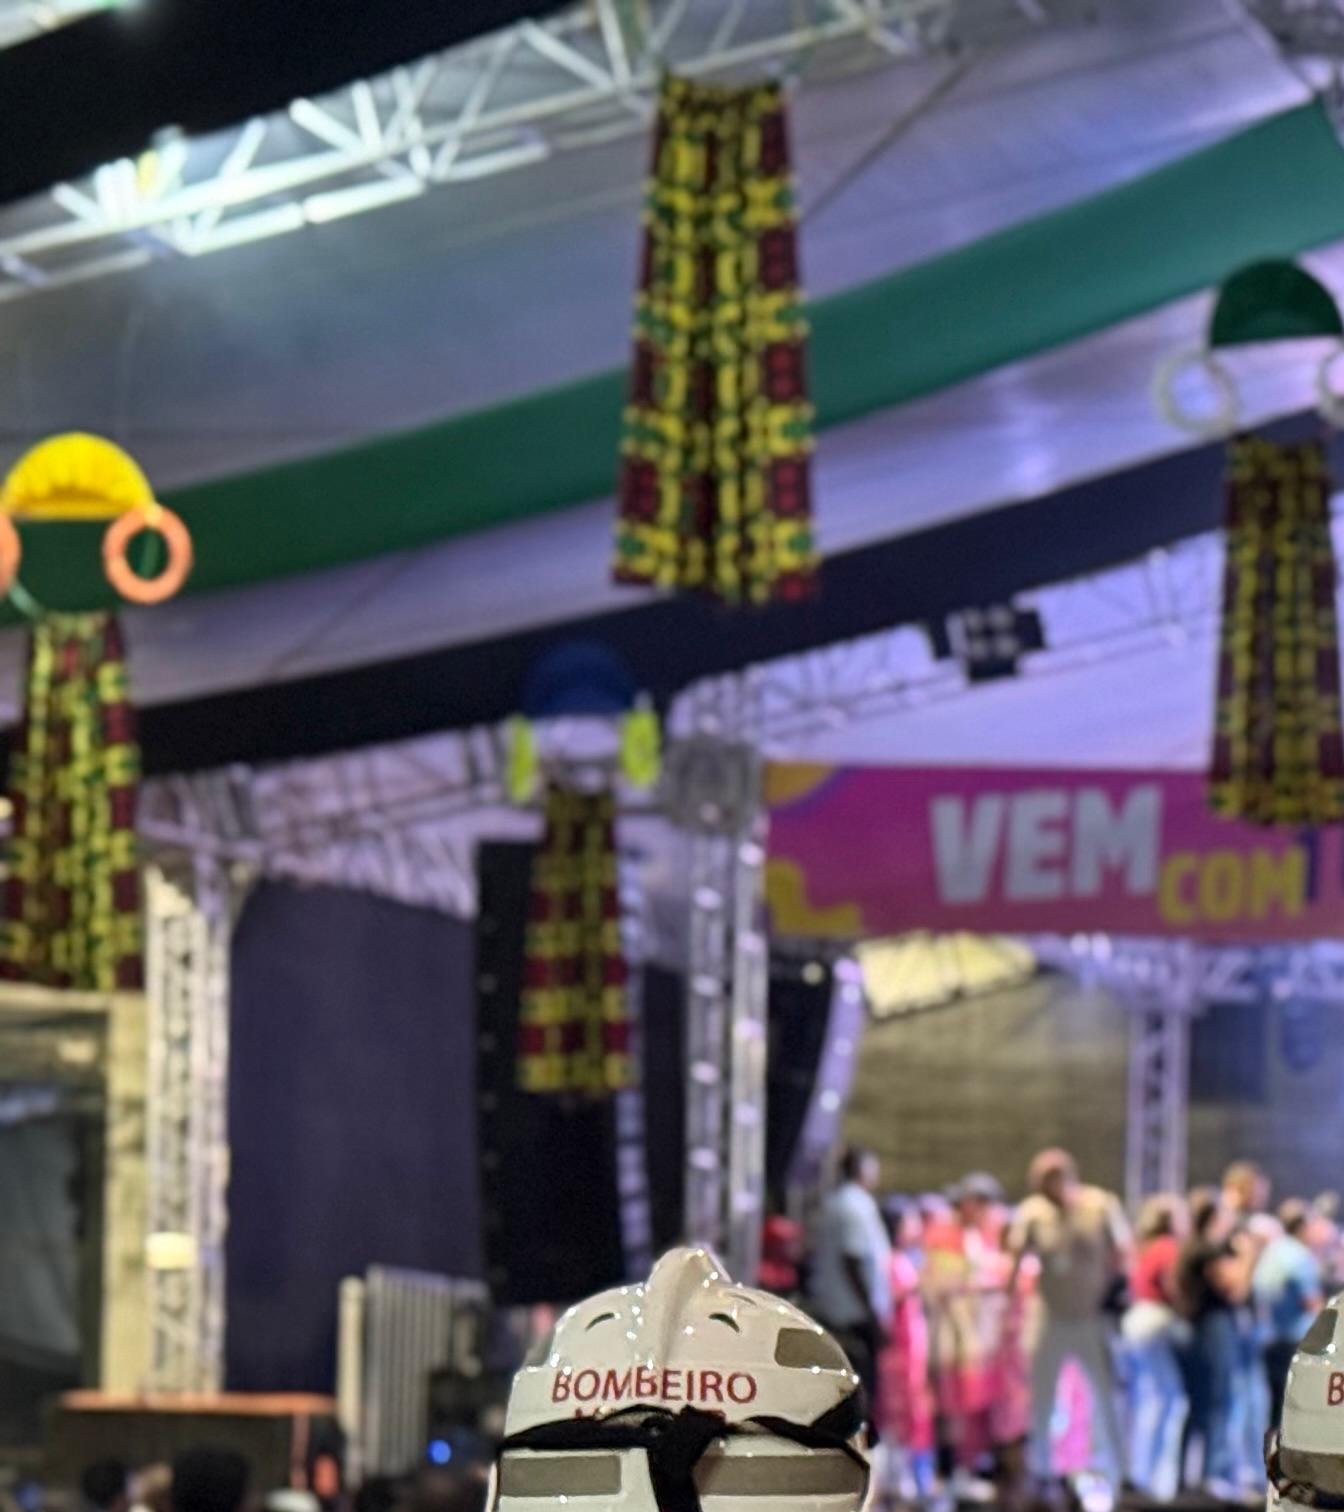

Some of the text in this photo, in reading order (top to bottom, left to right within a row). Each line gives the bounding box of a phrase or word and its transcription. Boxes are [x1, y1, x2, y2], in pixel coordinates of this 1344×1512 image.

[929, 784, 1162, 904] VEM
[1158, 845, 1308, 925] COM
[550, 1368, 758, 1403] BOMBEIRO
